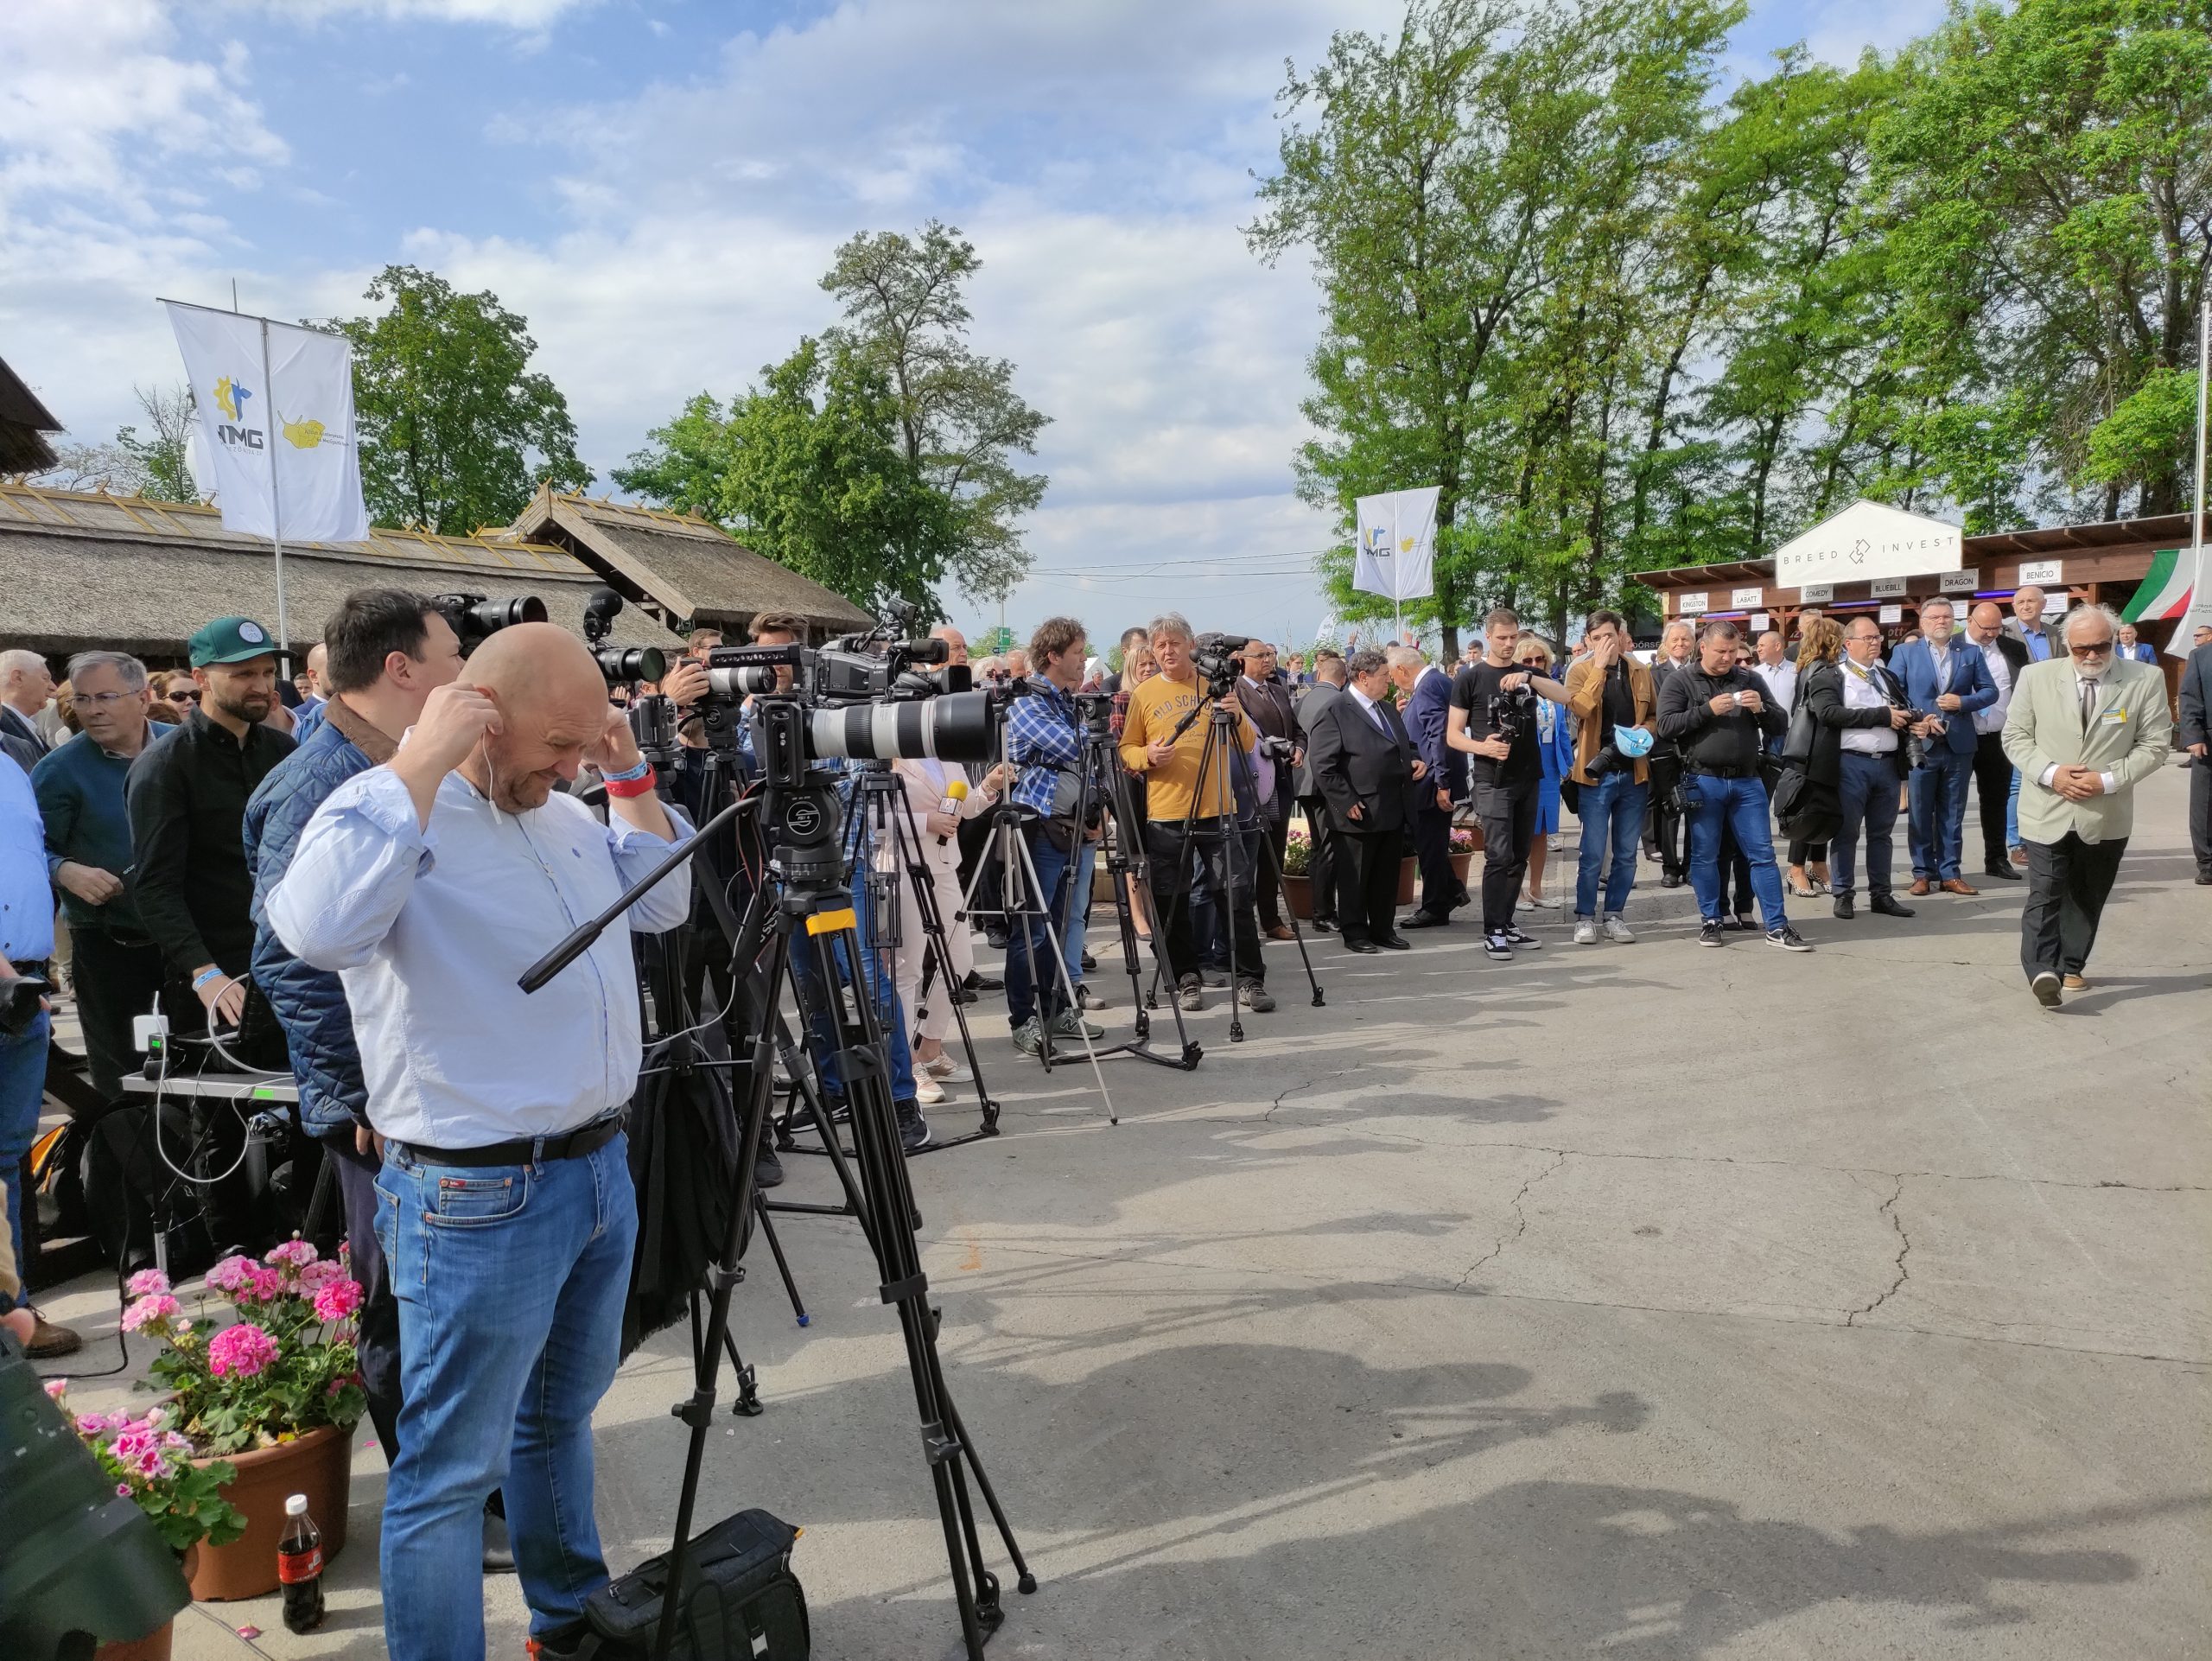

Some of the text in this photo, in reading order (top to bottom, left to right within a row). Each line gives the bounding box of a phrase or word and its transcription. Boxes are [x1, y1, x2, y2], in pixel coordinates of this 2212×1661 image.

[1783, 537, 1954, 564] BREED INVEST
[2026, 570, 2054, 580] BENICIO
[1944, 577, 1974, 587] DRAGON
[1805, 589, 1828, 598] COMEDY
[1154, 700, 1173, 720] OLD
